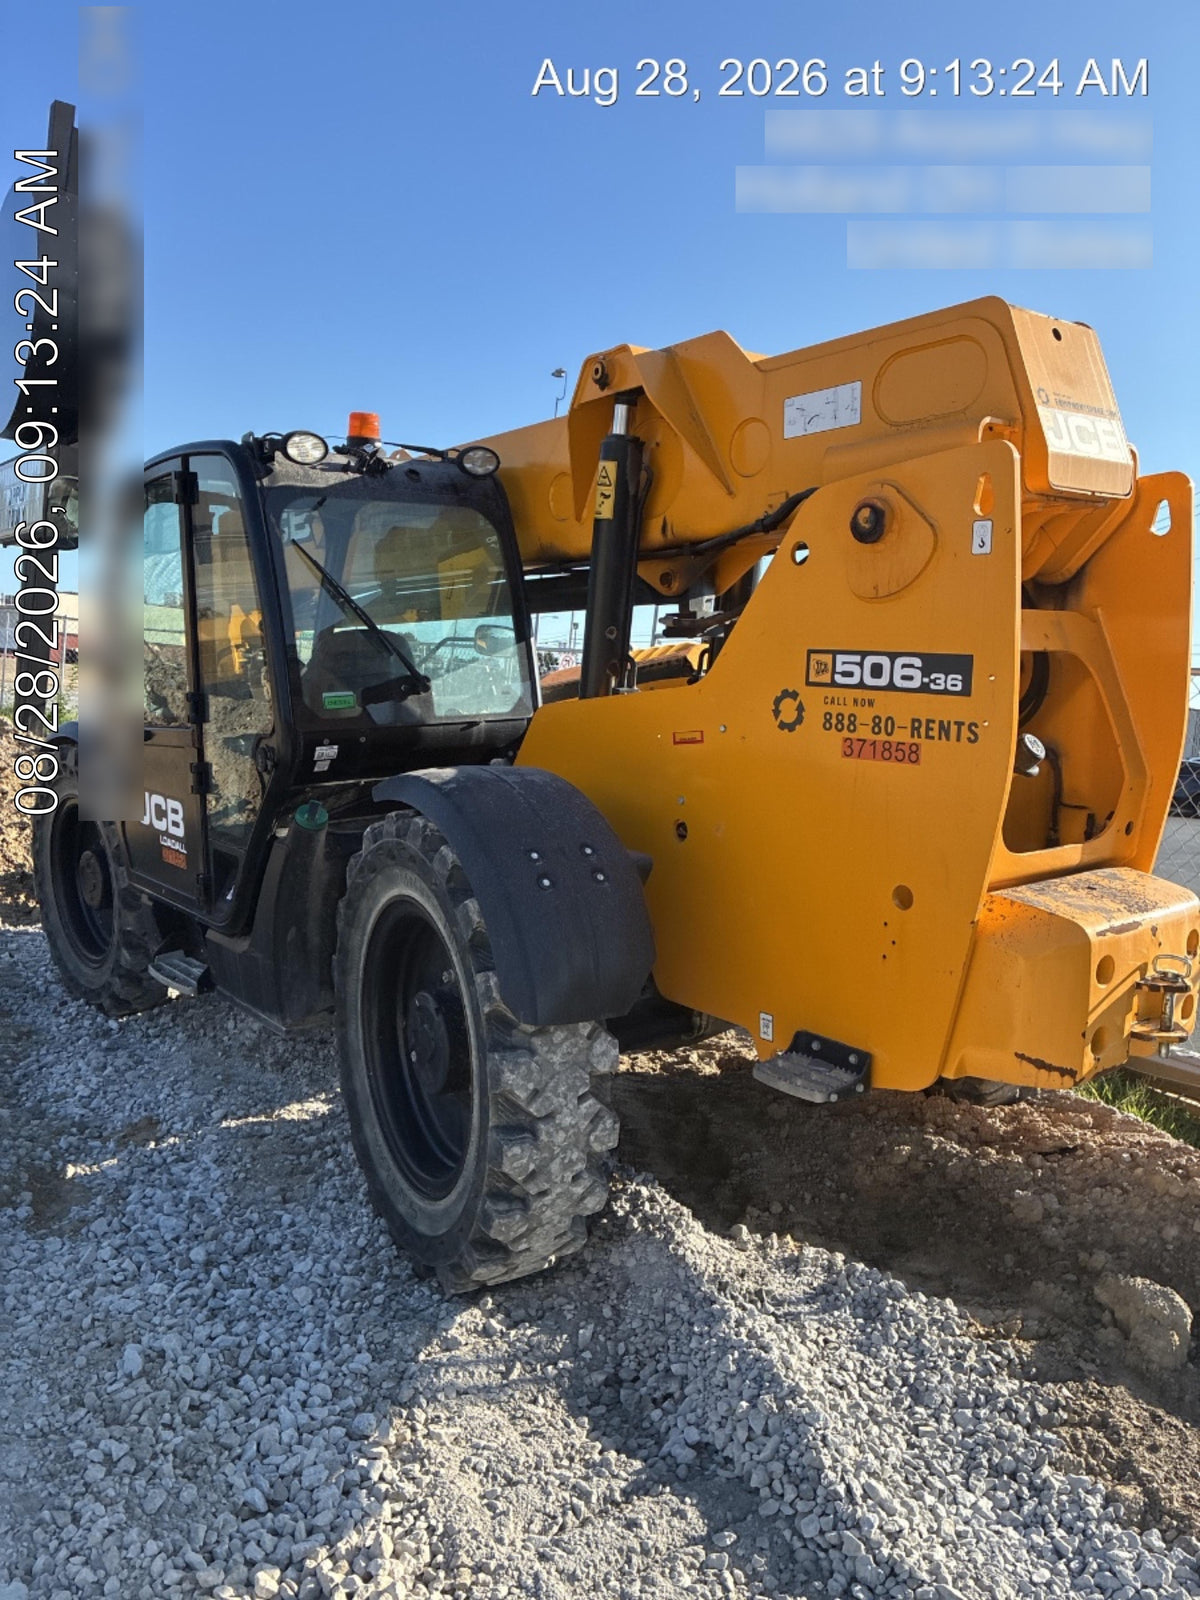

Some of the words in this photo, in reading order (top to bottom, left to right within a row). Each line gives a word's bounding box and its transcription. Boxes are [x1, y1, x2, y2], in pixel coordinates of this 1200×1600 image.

[1046, 410, 1129, 464] JCB
[823, 696, 848, 707] CALL
[852, 697, 876, 708] NOW
[822, 711, 980, 744] 888-80-RENTS
[842, 737, 920, 764] 371858
[140, 791, 185, 838] JCB
